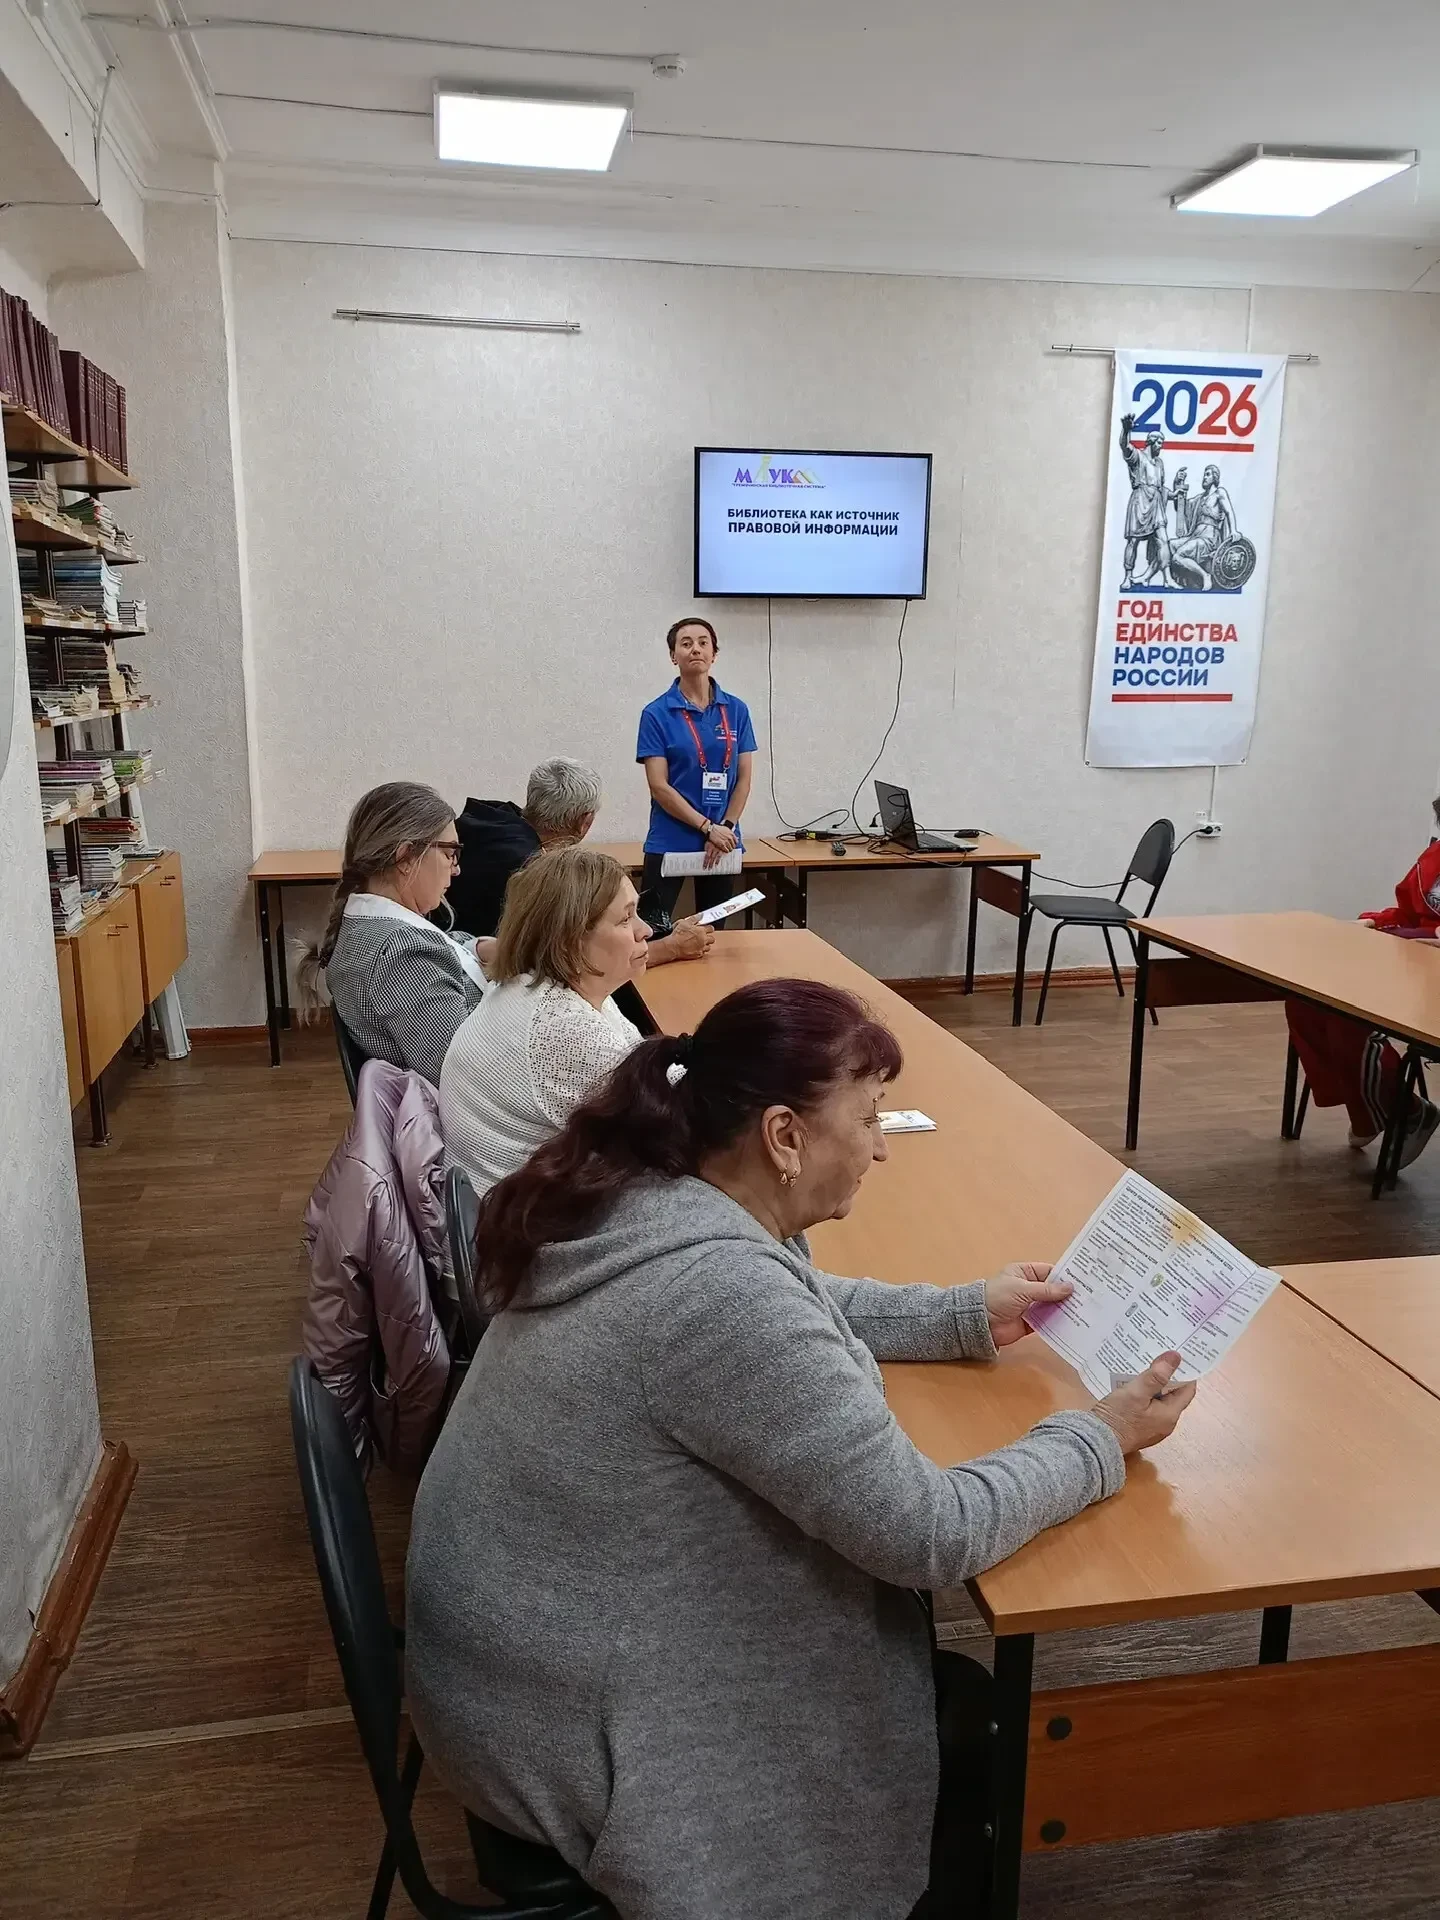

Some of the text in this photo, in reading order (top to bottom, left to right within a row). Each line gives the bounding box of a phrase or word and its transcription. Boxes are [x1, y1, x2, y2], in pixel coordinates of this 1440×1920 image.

[1131, 379, 1258, 438] 2026
[727, 508, 900, 521] БИБЛИОТЕКА КАК ИСТОЧНИК
[728, 521, 898, 537] ПРАВОВОЙ ИНФОРМАЦИИ
[1116, 599, 1164, 622] ГОД
[1115, 622, 1238, 644] ЕДИНСТВА
[1113, 646, 1225, 667] НАРОДОВ
[1112, 667, 1208, 687] РОССИИ
